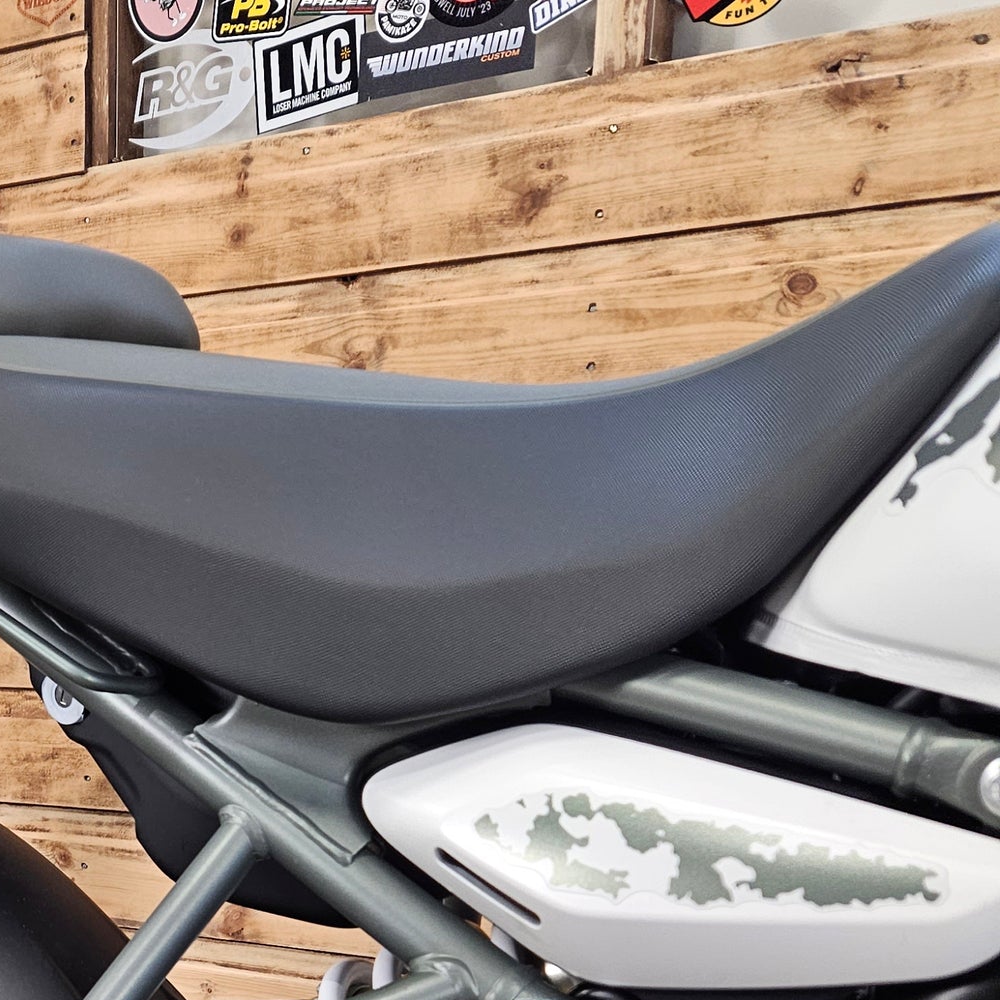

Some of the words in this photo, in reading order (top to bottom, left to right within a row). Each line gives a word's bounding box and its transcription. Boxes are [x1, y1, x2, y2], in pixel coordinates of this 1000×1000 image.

[456, 5, 477, 18] JULY
[725, 5, 755, 20] FUN
[270, 29, 352, 104] LMC
[366, 26, 526, 78] WUNDERKIND
[480, 48, 521, 63] CUSTOM
[136, 55, 235, 120] R&G
[272, 101, 292, 115] LOSER
[292, 90, 321, 110] MACHINE
[321, 81, 353, 99] COMPANY
